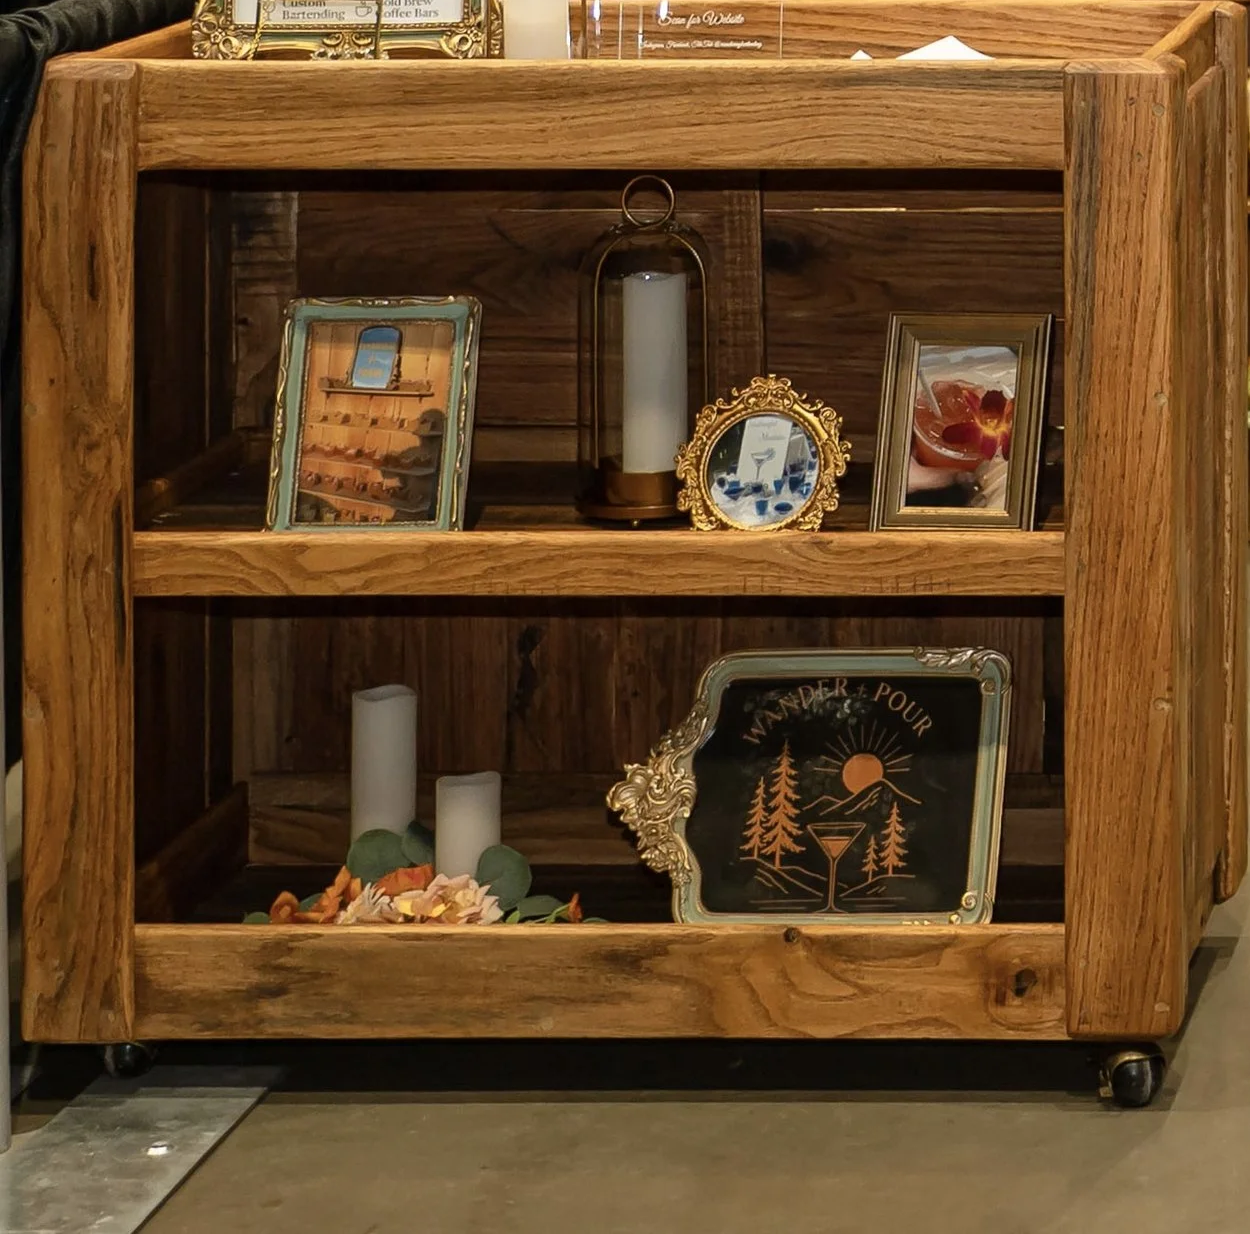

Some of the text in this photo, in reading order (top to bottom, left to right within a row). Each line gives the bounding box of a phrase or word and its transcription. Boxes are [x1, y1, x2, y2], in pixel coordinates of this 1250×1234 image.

[282, 0, 326, 8] Custom
[282, 10, 346, 21] Bartending
[414, 9, 440, 18] Bars
[658, 10, 745, 29] Scan for Website
[742, 677, 848, 744] WANDER
[874, 682, 932, 738] POUR
